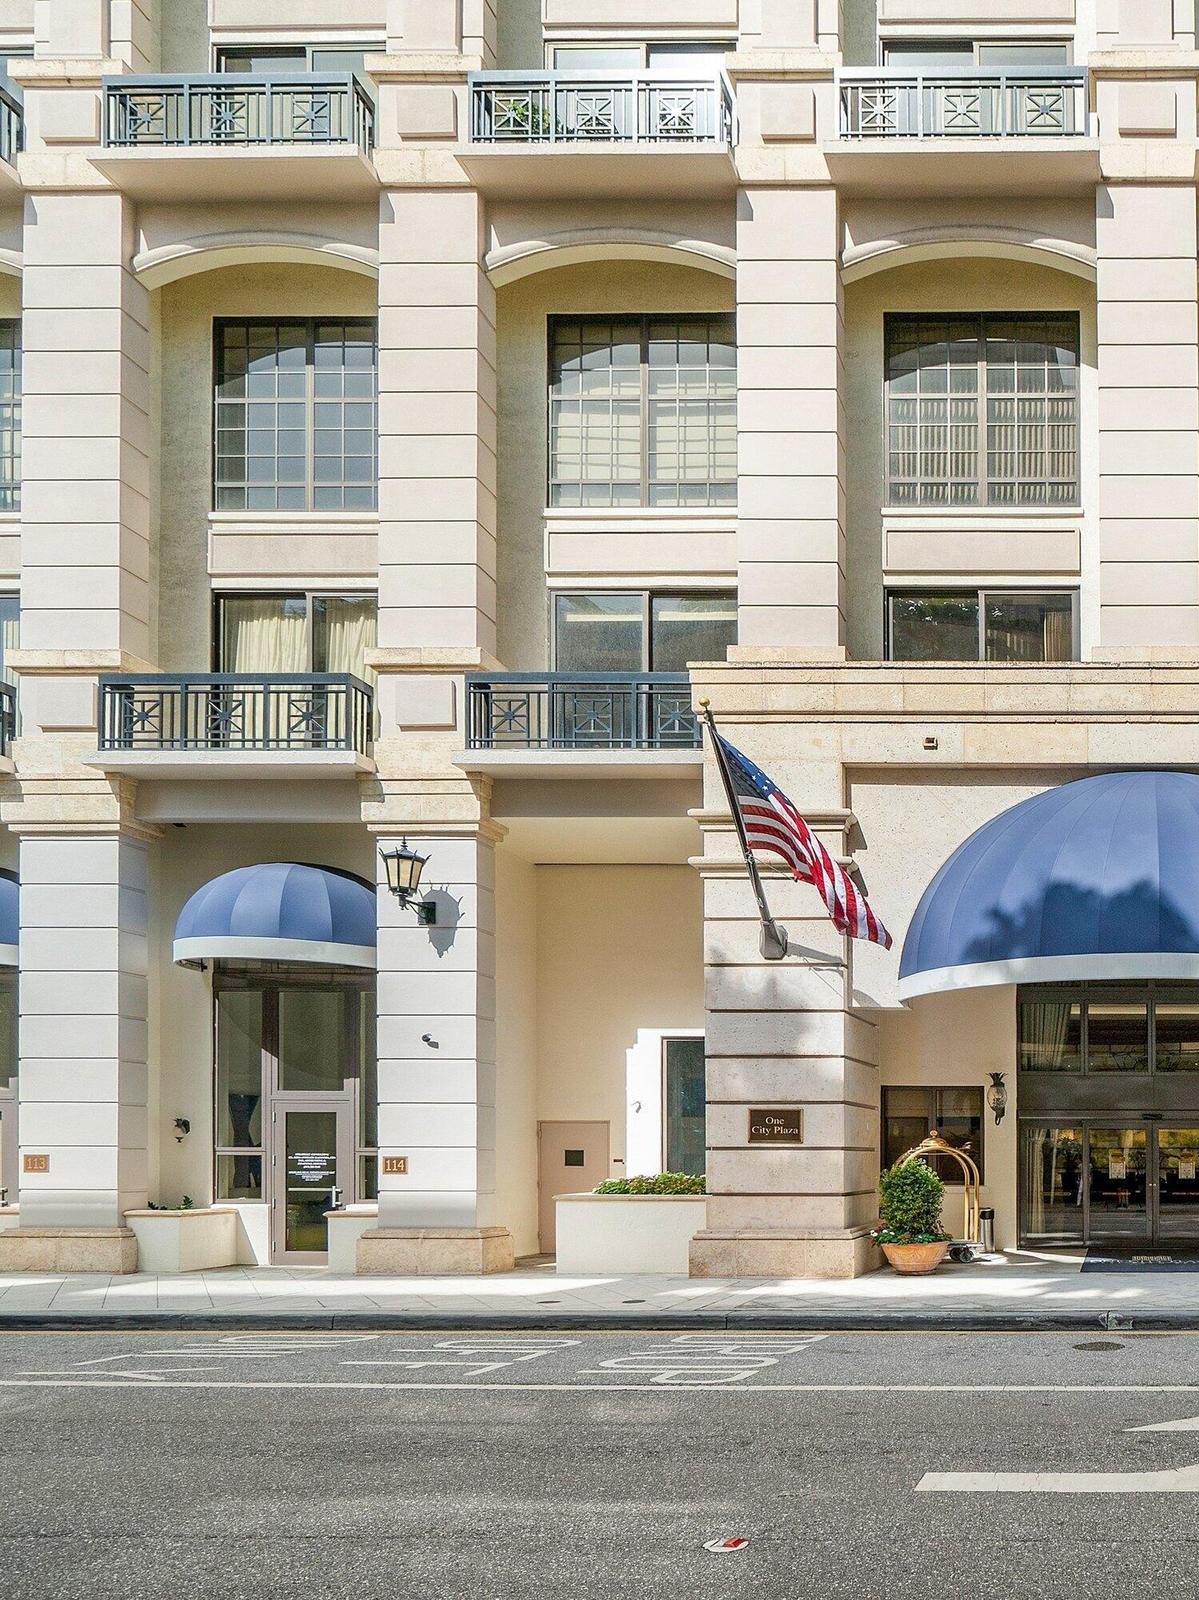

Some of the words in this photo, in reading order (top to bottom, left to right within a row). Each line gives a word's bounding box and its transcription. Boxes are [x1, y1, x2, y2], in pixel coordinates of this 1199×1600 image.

[765, 1116, 785, 1125] One
[751, 1125, 771, 1136] City
[774, 1125, 799, 1135] Plaza
[26, 1157, 46, 1169] 113
[385, 1159, 405, 1171] 114
[14, 1334, 381, 1381] ONLY
[337, 1339, 584, 1376] OFF
[577, 1334, 830, 1384] DROP
